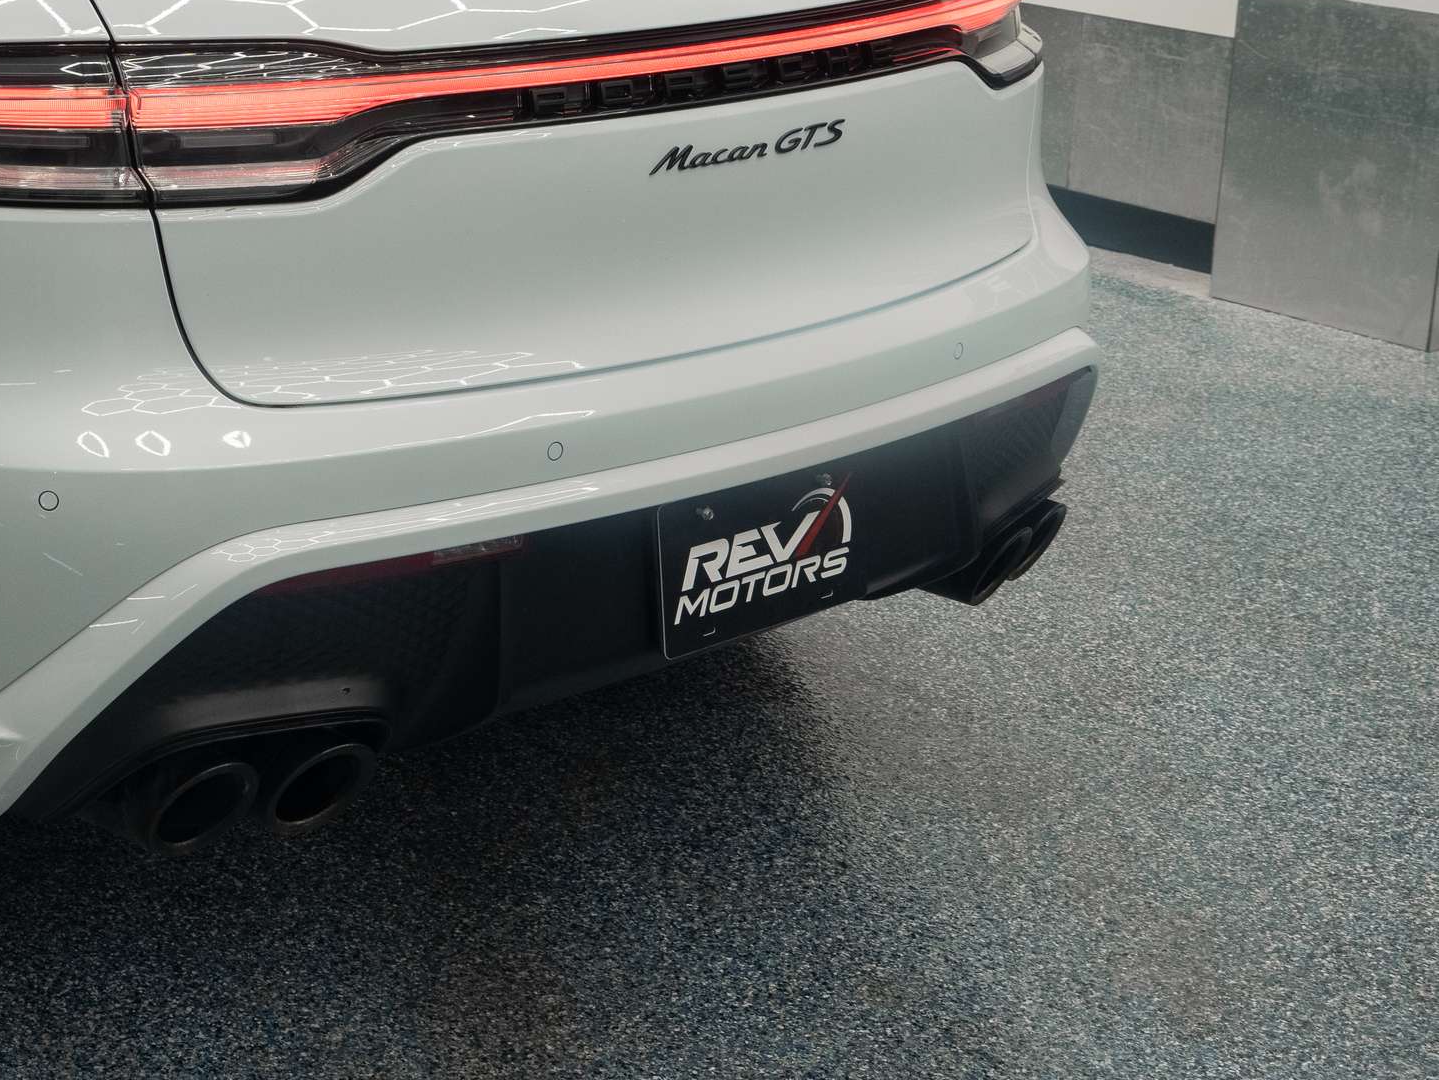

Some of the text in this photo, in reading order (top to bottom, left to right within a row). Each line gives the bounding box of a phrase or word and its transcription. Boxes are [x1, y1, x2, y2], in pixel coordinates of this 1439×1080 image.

[649, 118, 846, 176] Macan GTS
[673, 546, 850, 626] MOTORS
[681, 510, 821, 592] REV
